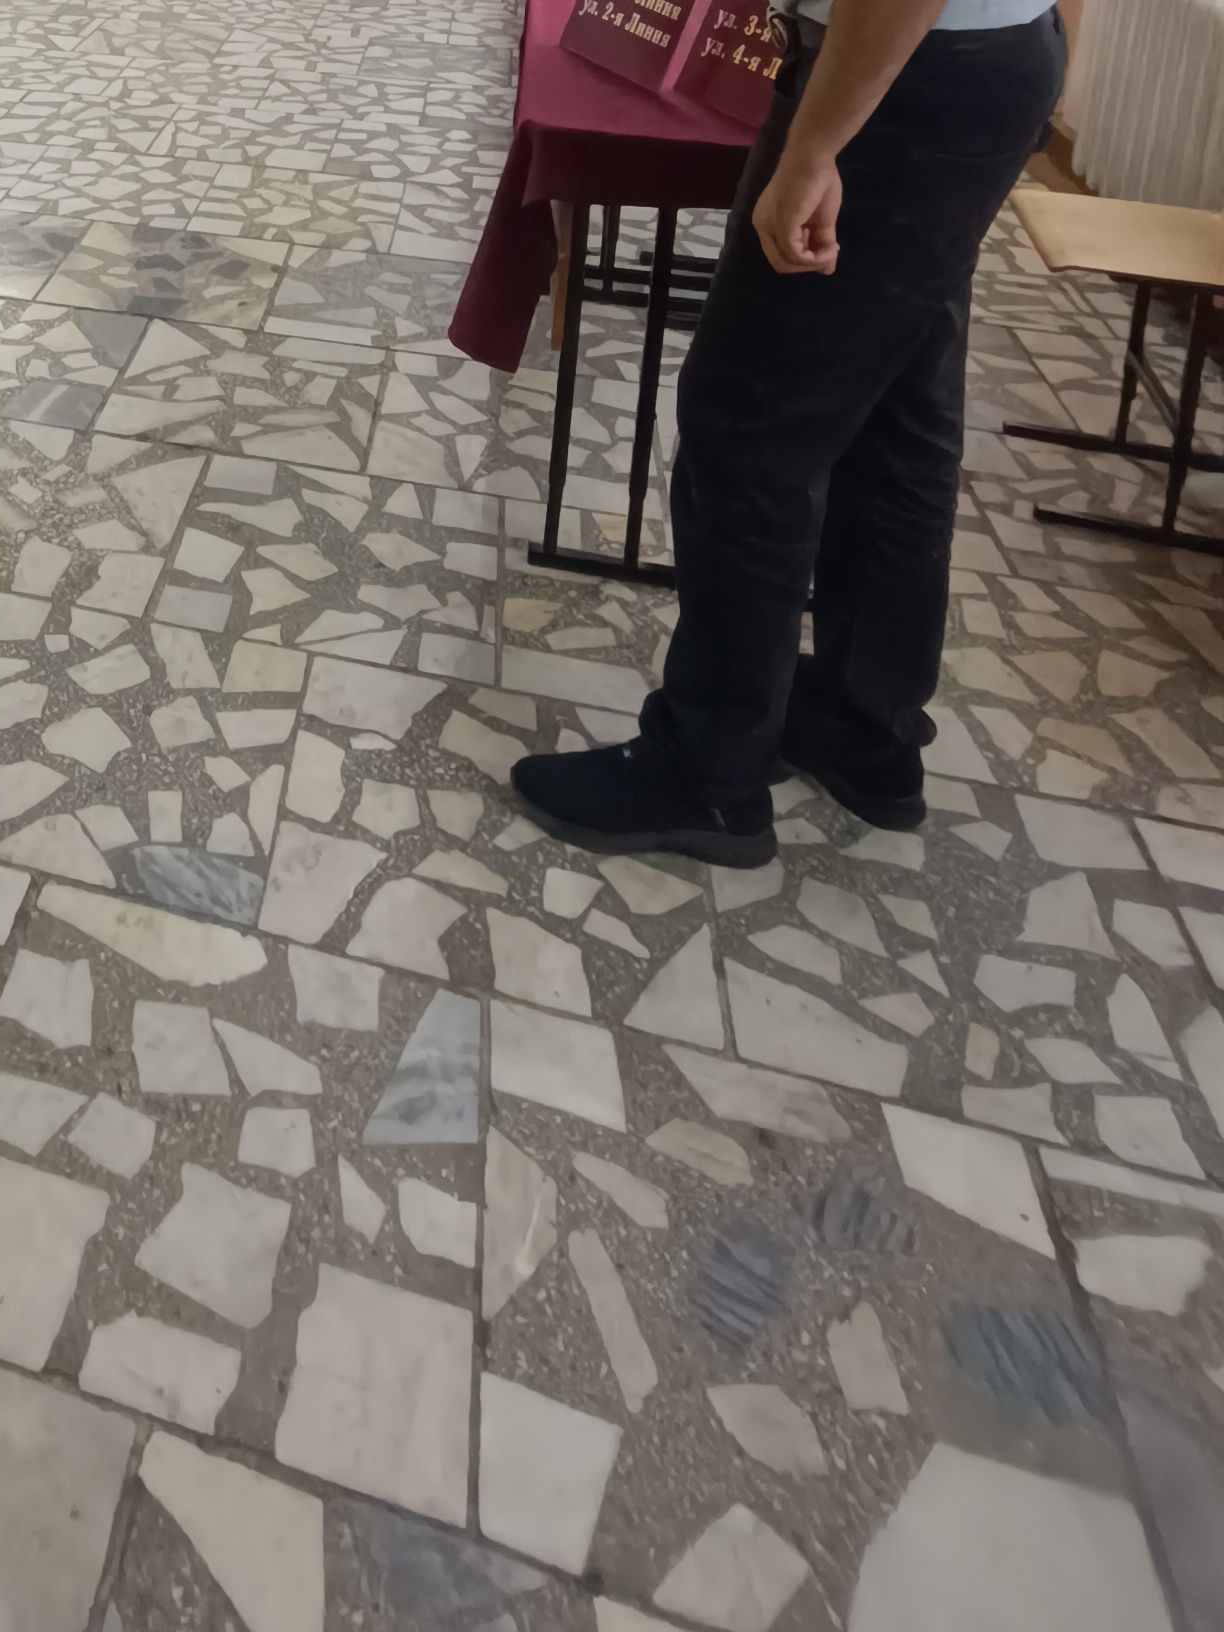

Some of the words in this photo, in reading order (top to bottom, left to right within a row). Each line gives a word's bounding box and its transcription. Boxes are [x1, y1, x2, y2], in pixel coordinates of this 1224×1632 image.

[601, 2, 625, 27] 2-я
[624, 12, 672, 48] Линия
[713, 9, 738, 30] ул.
[743, 15, 772, 42] 3-я
[700, 37, 726, 59] ул.
[732, 44, 762, 72] 4-я
